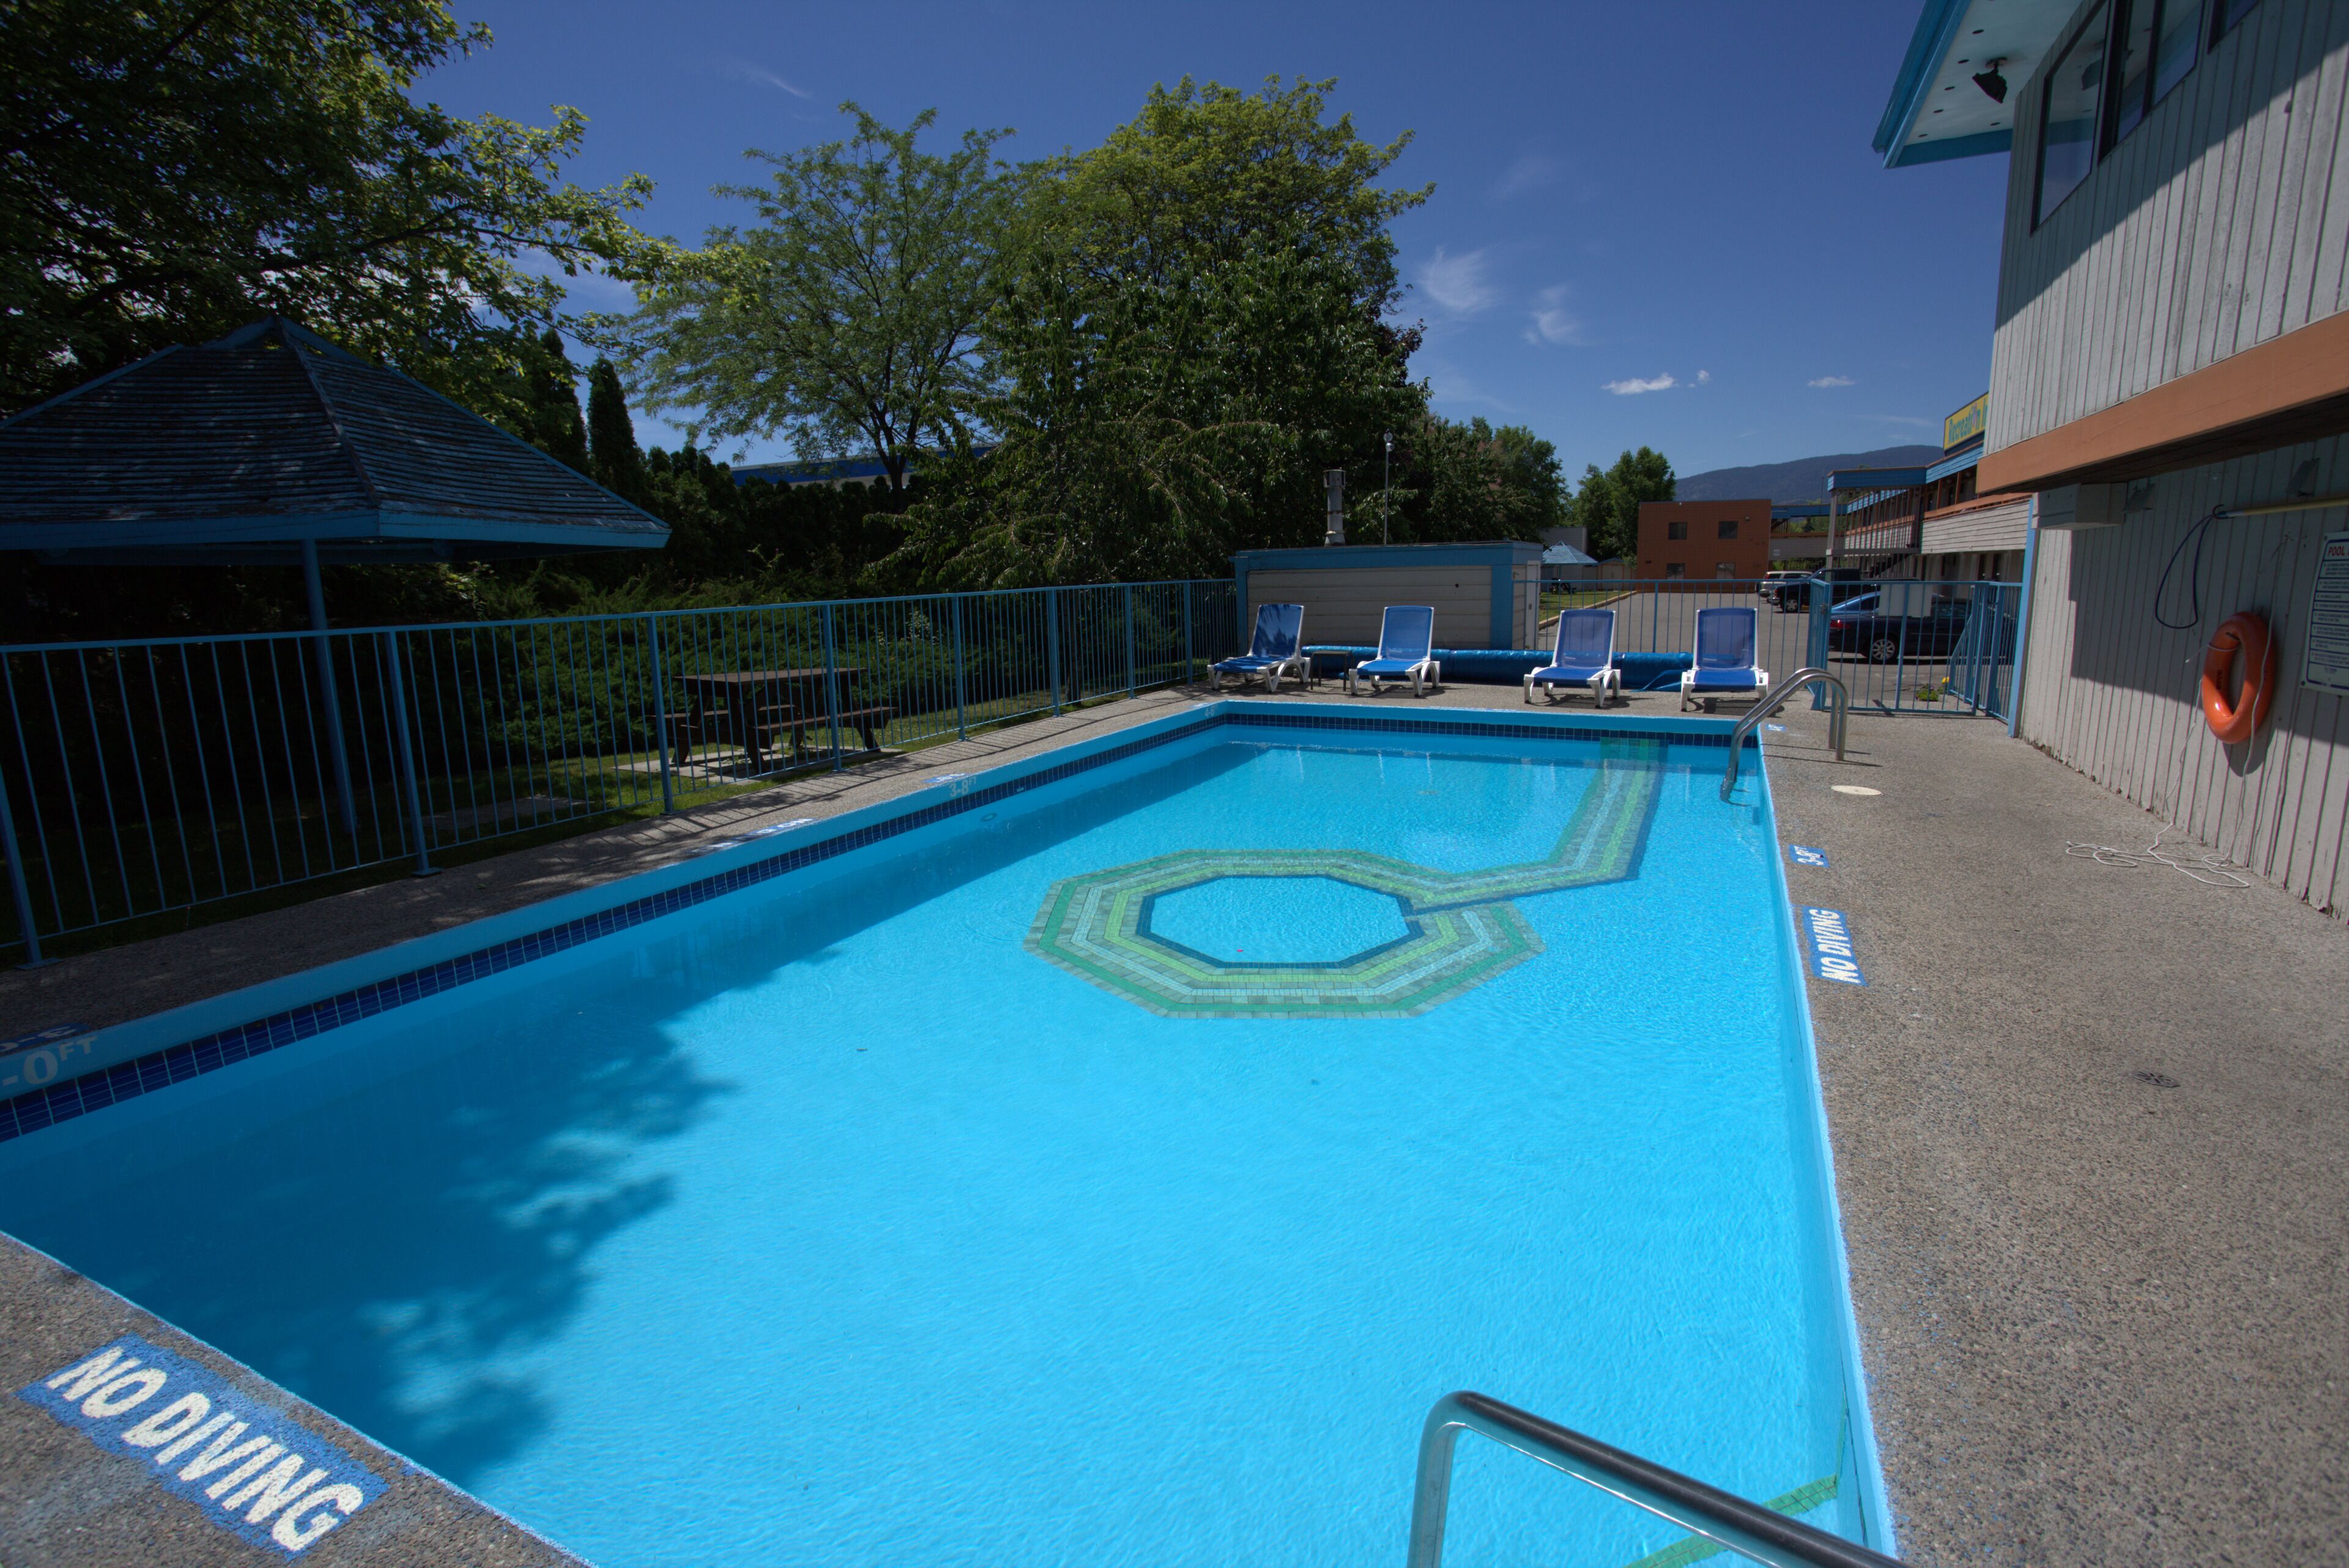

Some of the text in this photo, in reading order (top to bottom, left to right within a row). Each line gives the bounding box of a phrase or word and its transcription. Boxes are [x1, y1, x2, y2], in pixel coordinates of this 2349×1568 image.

[2328, 546, 2345, 557] POOL
[1809, 909, 1861, 984] NO DIVING
[46, 1347, 363, 1552] NO DIVING
